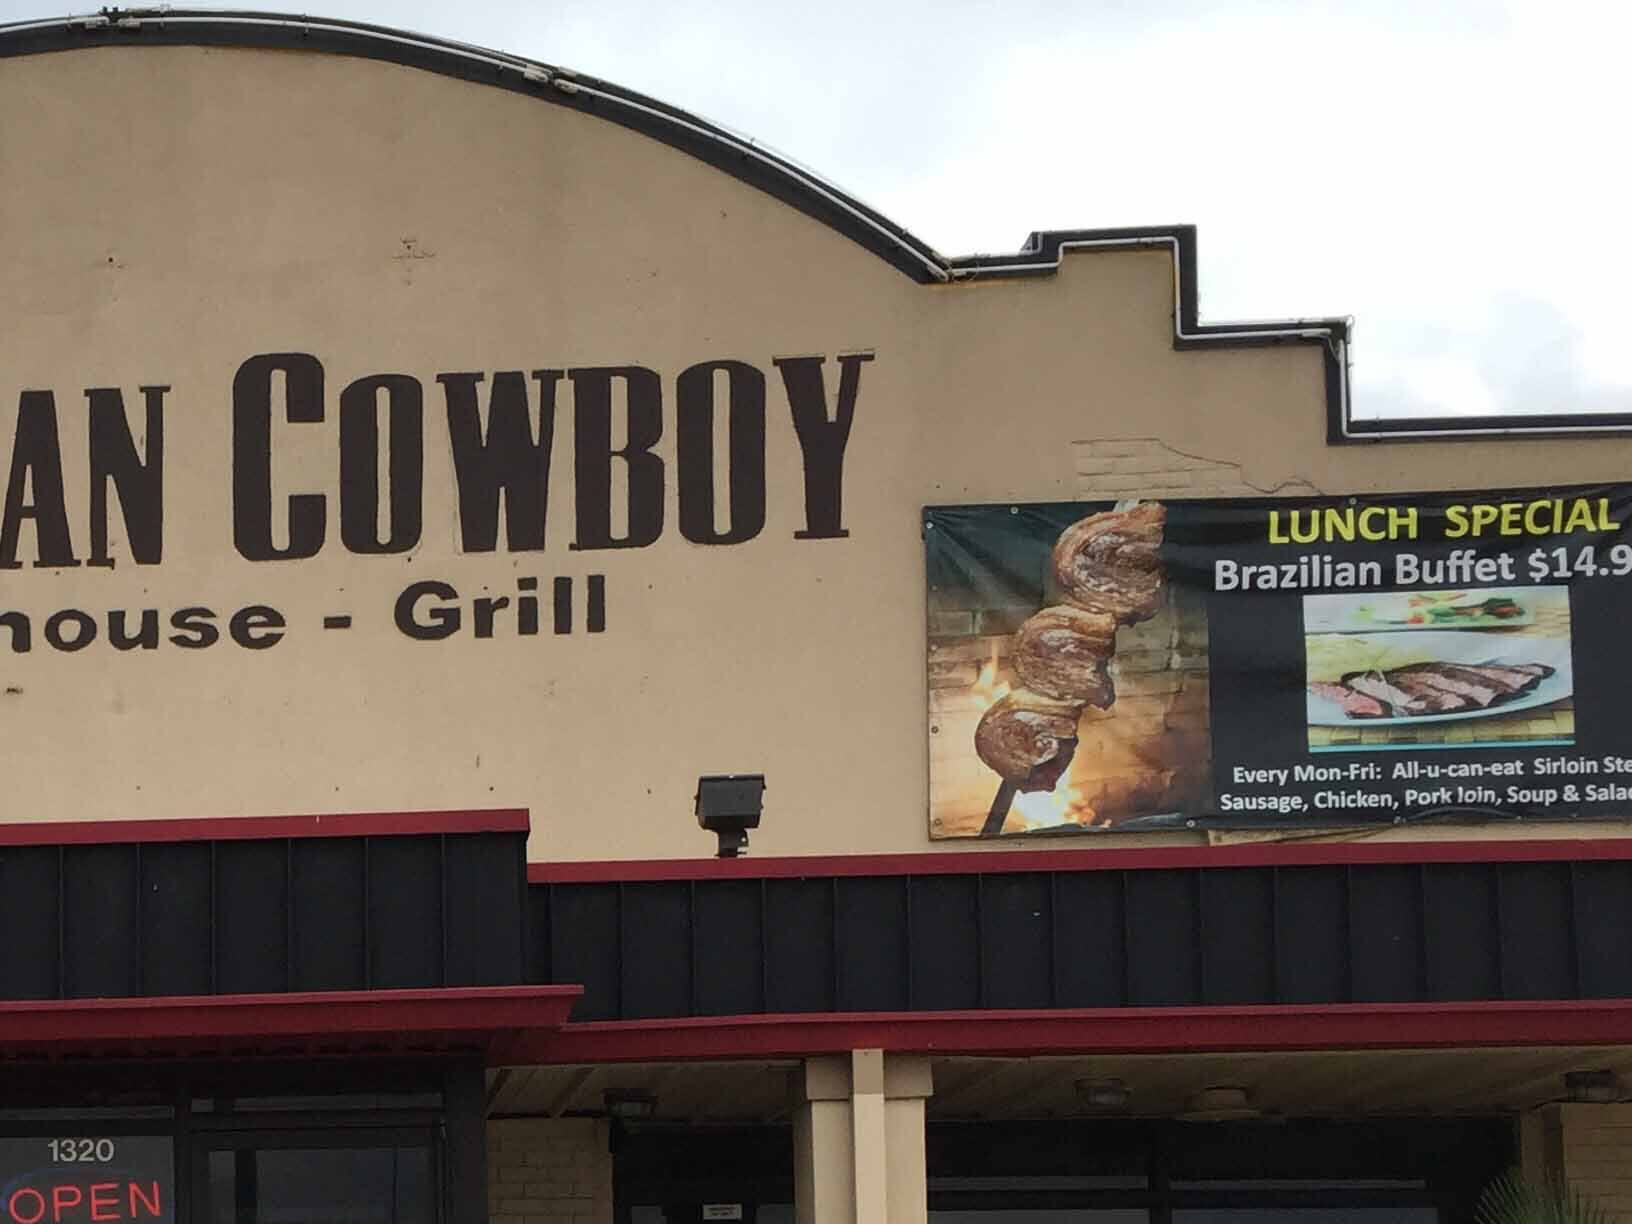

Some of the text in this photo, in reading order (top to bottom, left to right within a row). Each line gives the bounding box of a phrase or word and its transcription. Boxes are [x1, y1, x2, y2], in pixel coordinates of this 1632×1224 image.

[232, 350, 876, 562] COWBOY
[1268, 498, 1621, 544] LUNCH SPECIAL
[1214, 554, 1382, 591] Brazilian
[1396, 549, 1516, 586] Buffet
[394, 575, 605, 640] Grill
[1233, 767, 1288, 786] Every
[1294, 763, 1382, 782] Mon-Fri:
[1392, 760, 1524, 778] All-u-can-eat
[1534, 757, 1598, 775] Sirloin
[1220, 783, 1632, 812] Sausage, Chicken, Pork loin, Soup & Sala
[48, 1138, 114, 1162] 1320
